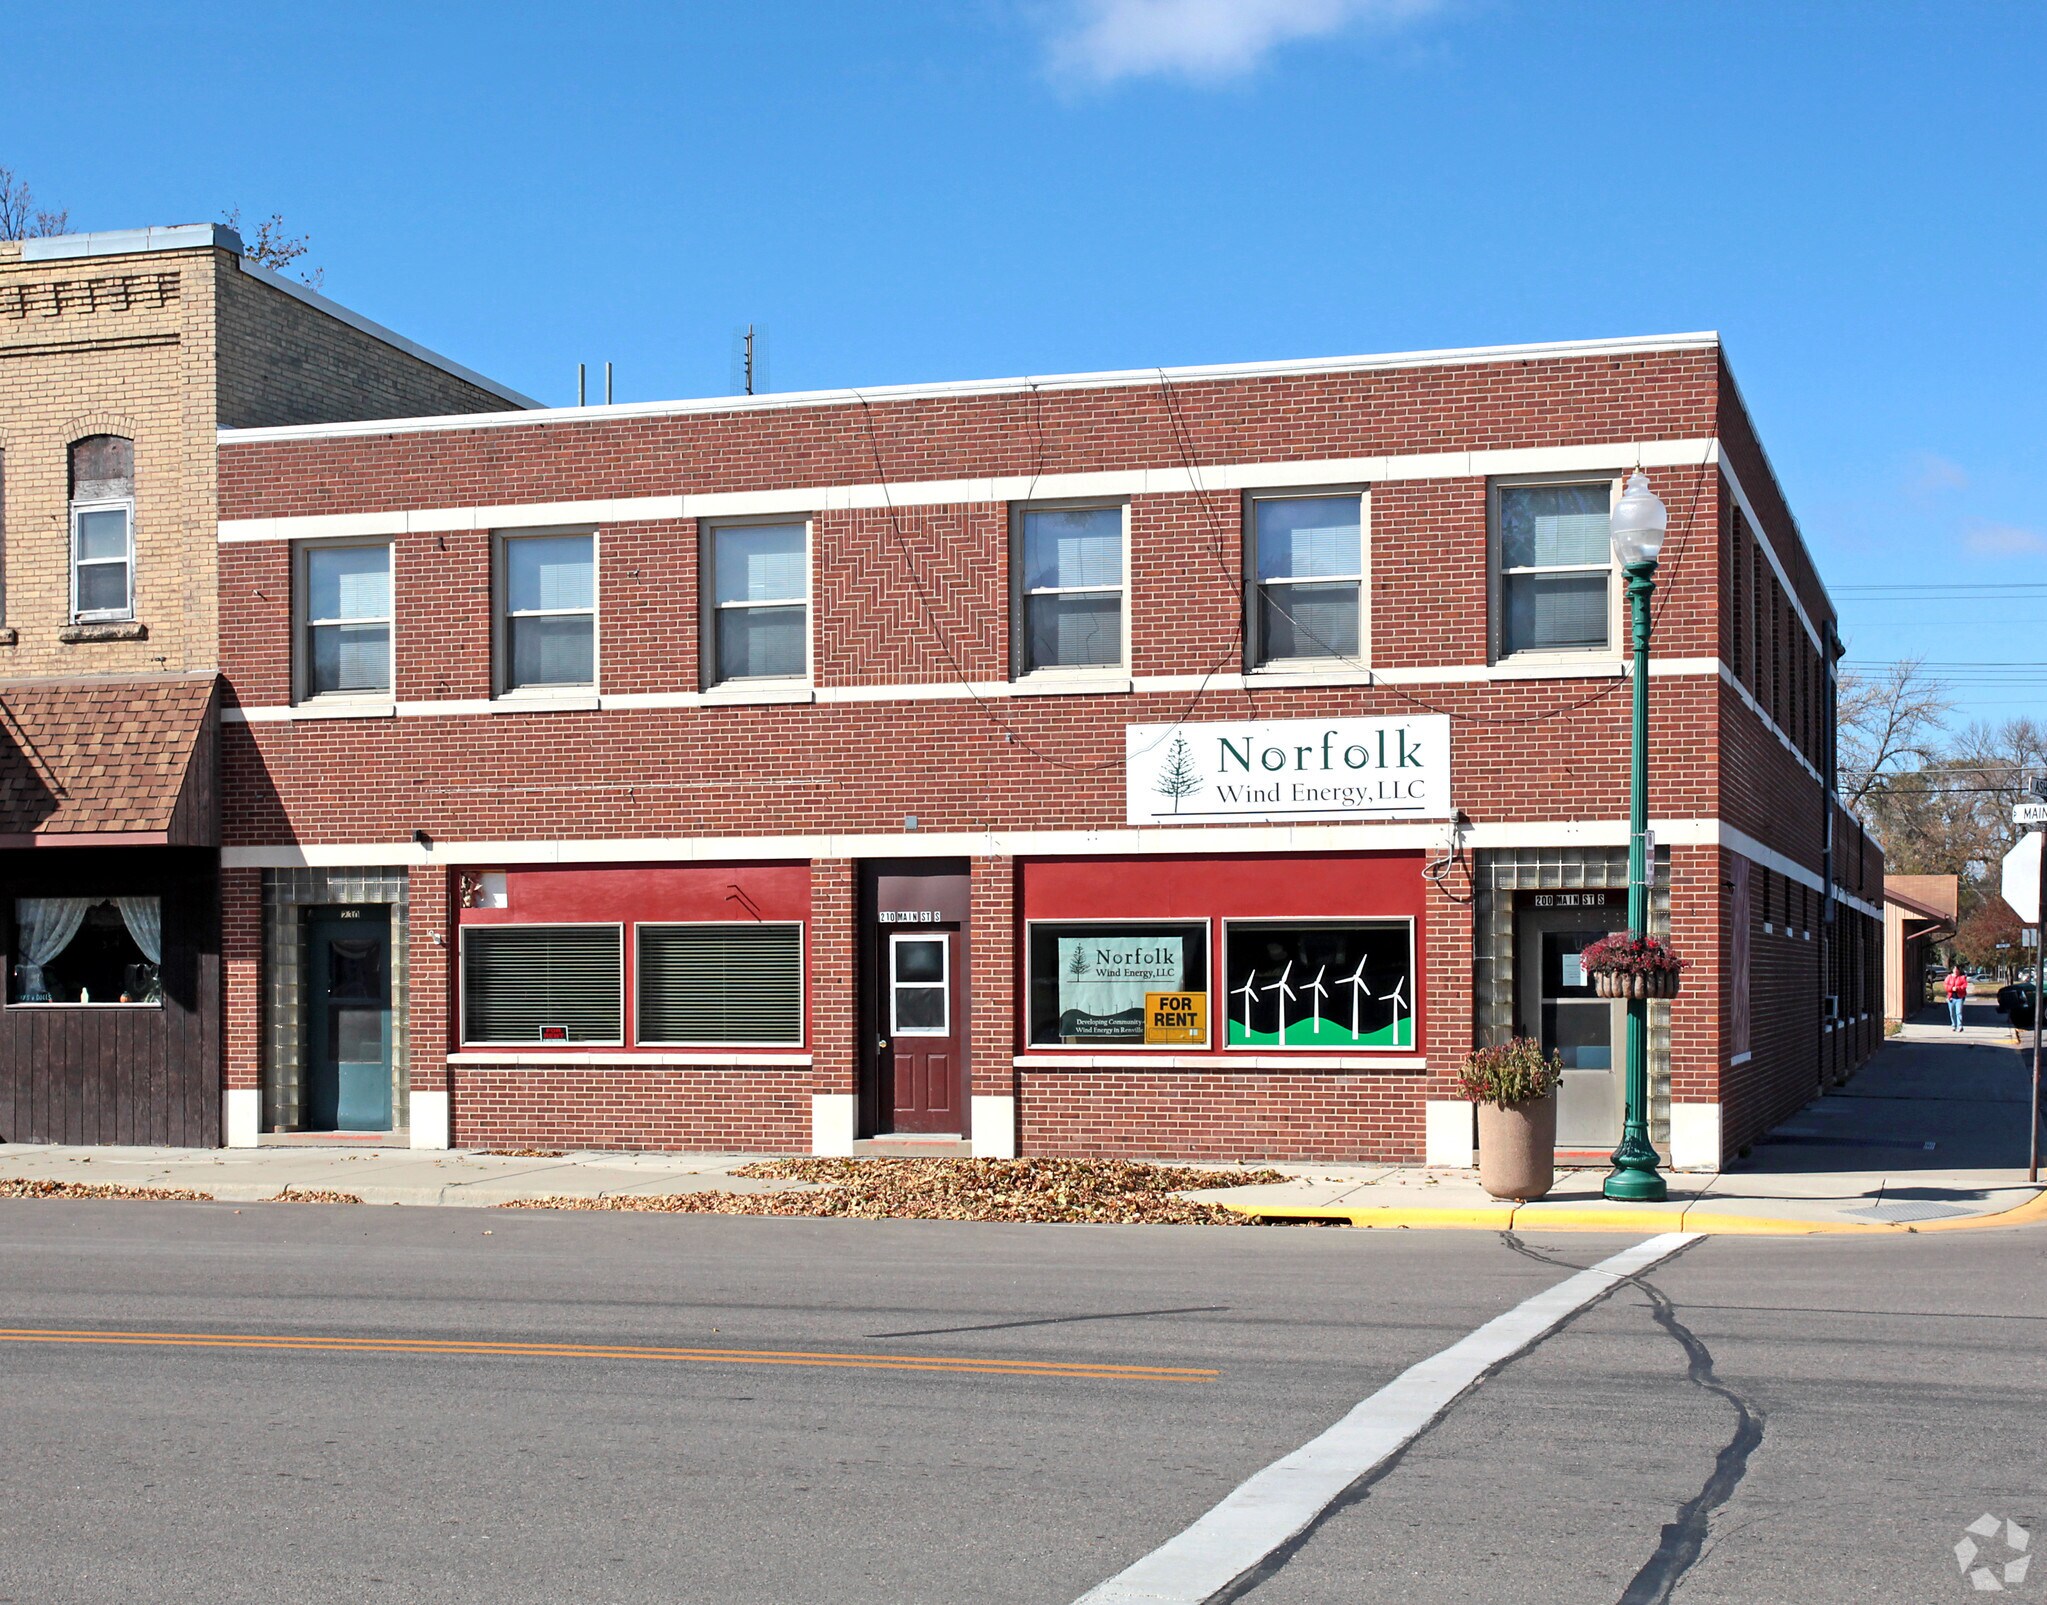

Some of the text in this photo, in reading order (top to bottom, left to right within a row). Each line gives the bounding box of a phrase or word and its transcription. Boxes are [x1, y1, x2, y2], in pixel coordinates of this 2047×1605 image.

[1217, 728, 1424, 773] Norfolk
[1216, 779, 1425, 806] Wind Energy, LLC
[2023, 807, 2047, 819] MAIN
[1536, 894, 1604, 906] 200 MAIN ST S
[880, 912, 940, 921] 210 MAIN ST S
[1096, 948, 1174, 965] Norfolk
[1096, 968, 1175, 979] Wind Energy, LLC
[1160, 996, 1192, 1011] FOR
[1076, 1018, 1108, 1027] Developing
[1154, 1012, 1198, 1027] RENT
[1093, 1026, 1113, 1034] Energy
